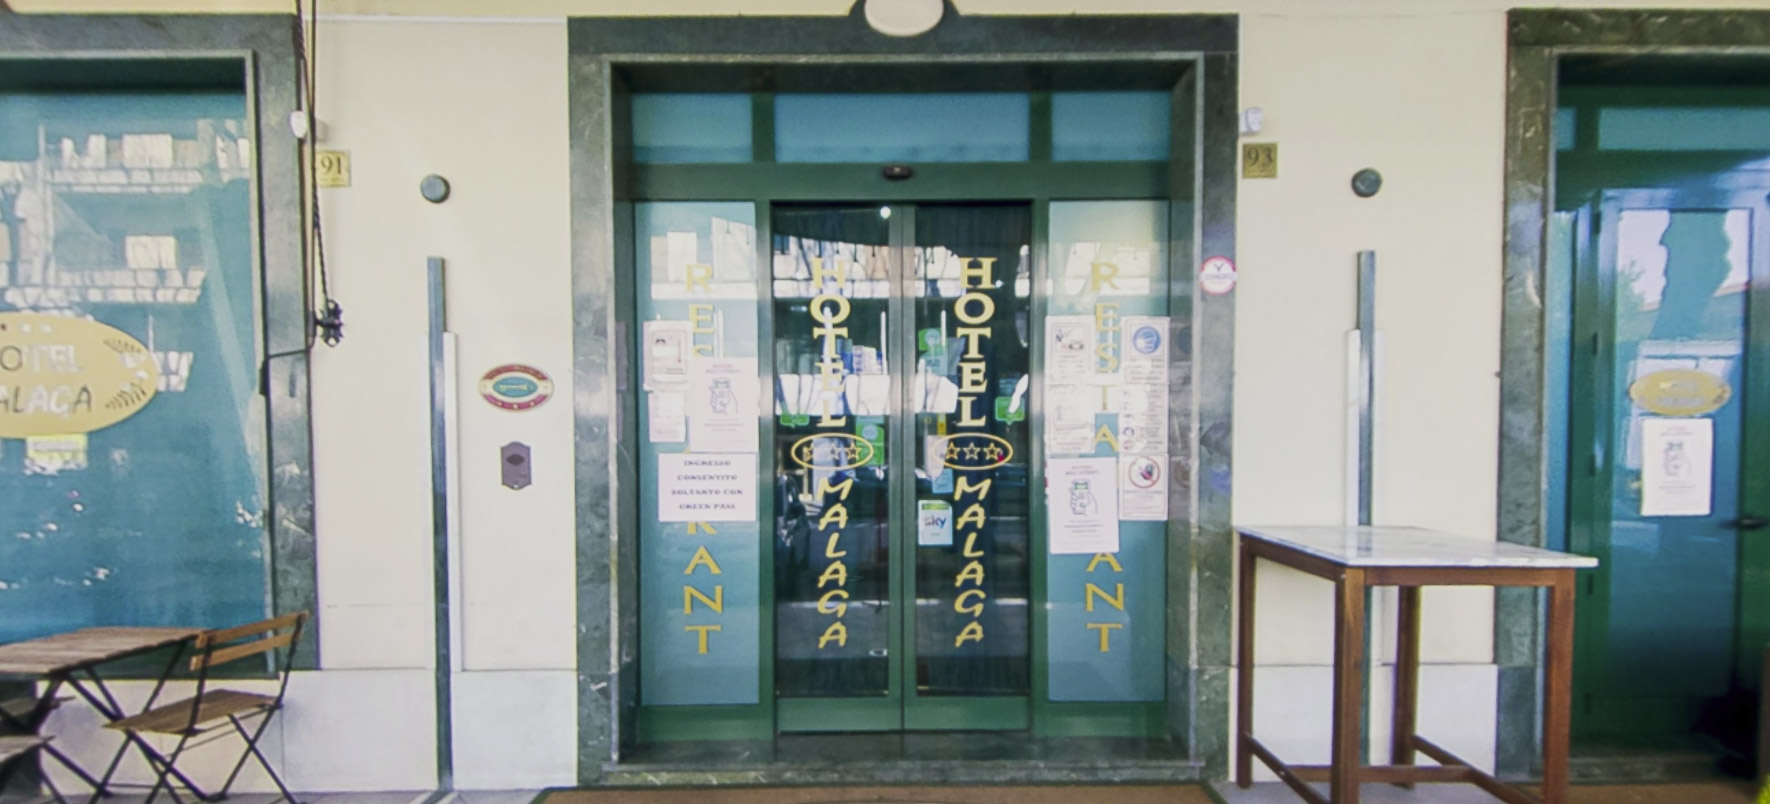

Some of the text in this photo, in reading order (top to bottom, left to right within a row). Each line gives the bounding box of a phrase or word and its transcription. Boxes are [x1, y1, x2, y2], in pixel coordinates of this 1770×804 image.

[321, 156, 342, 175] 91
[1248, 147, 1273, 167] 93
[0, 345, 83, 373] OTEL
[810, 257, 851, 428] HOTEL
[954, 256, 998, 427] HOTEL
[0, 384, 92, 418] ALAGA
[1086, 261, 1125, 653] RESTAANT
[817, 478, 853, 649] MALAGA
[924, 514, 947, 529] sky
[953, 476, 992, 648] MALAGA
